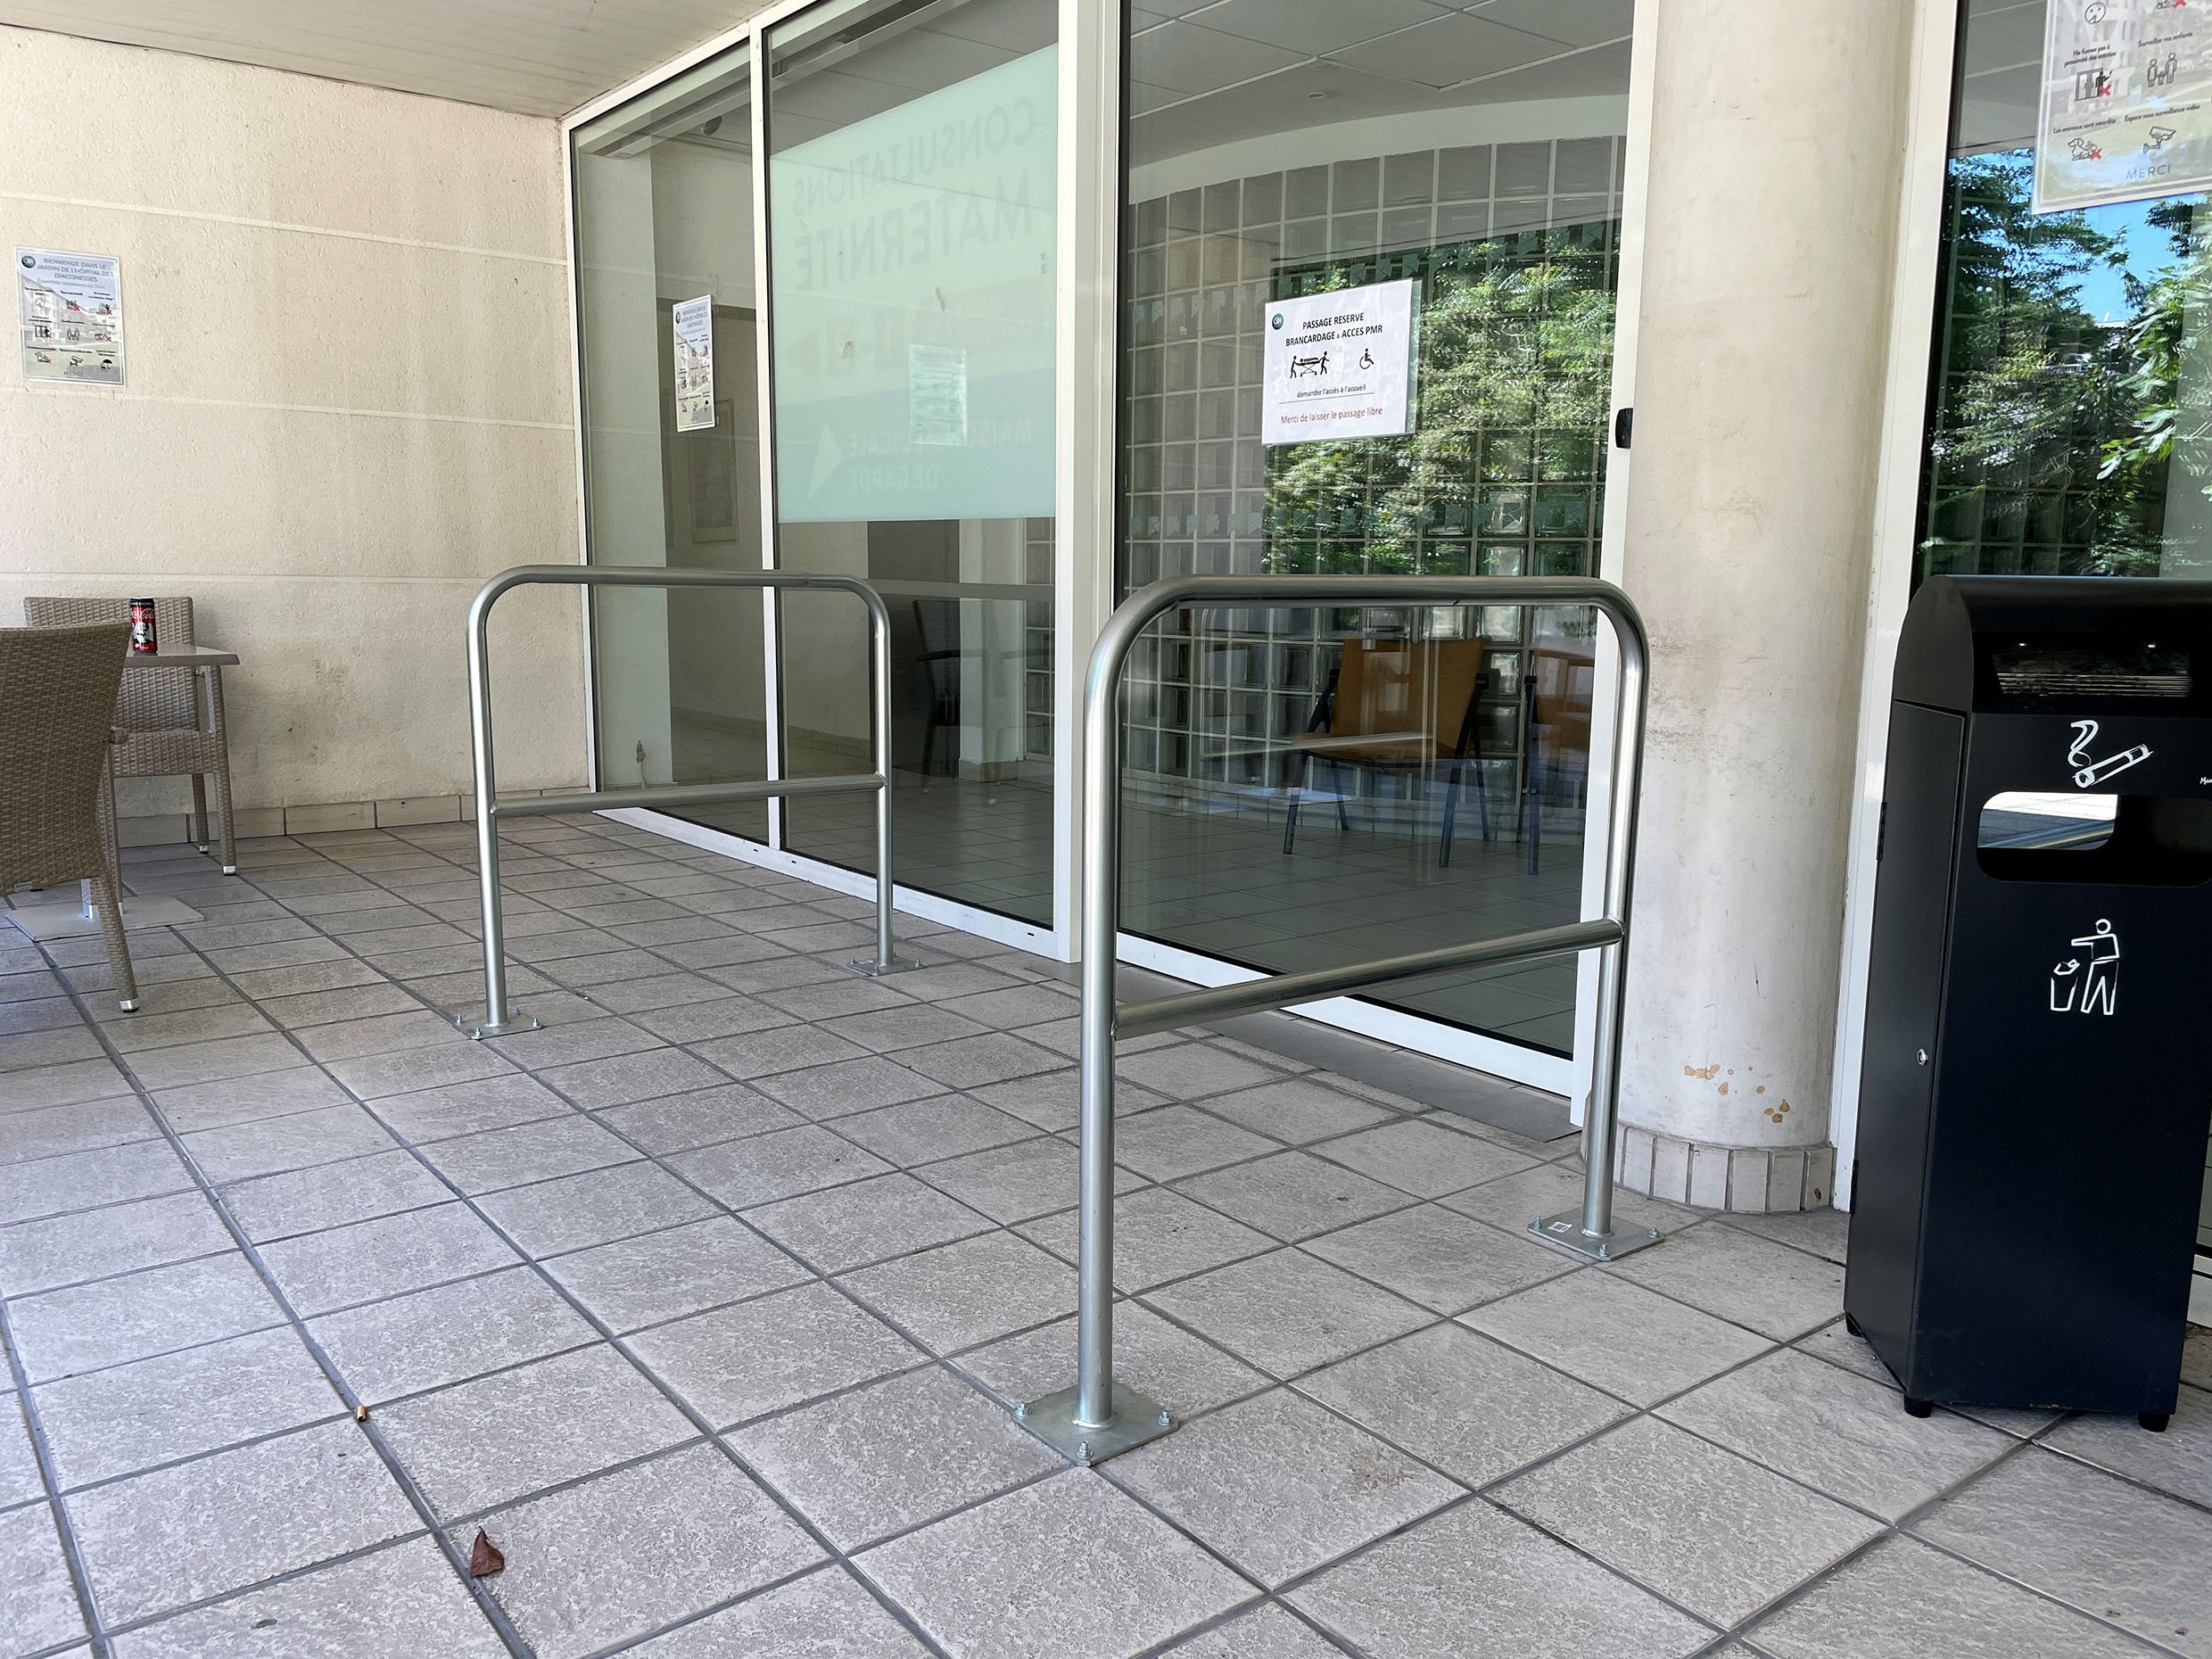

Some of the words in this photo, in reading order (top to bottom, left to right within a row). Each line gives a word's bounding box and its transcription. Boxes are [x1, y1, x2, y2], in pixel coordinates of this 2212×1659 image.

[2126, 164, 2170, 179] MERCI
[44, 258, 78, 267] BIENVENUE
[54, 273, 98, 282] DIACONESSES
[1302, 317, 1333, 330] PASSAGE
[1333, 312, 1365, 326] RESERVE
[1285, 331, 1335, 346] BRANCARDAGE
[1341, 326, 1364, 339] ACCES
[1366, 324, 1383, 334] PMR
[1297, 389, 1322, 398] demander
[1323, 386, 1339, 395] l'accès
[1340, 385, 1344, 393] à
[1344, 384, 1366, 392] l'accueil
[1281, 414, 1299, 425] Merci
[1300, 413, 1308, 423] de
[1309, 411, 1330, 421] laisser
[1331, 409, 1337, 419] le
[1338, 409, 1366, 420] passage
[1367, 406, 1383, 417] libre
